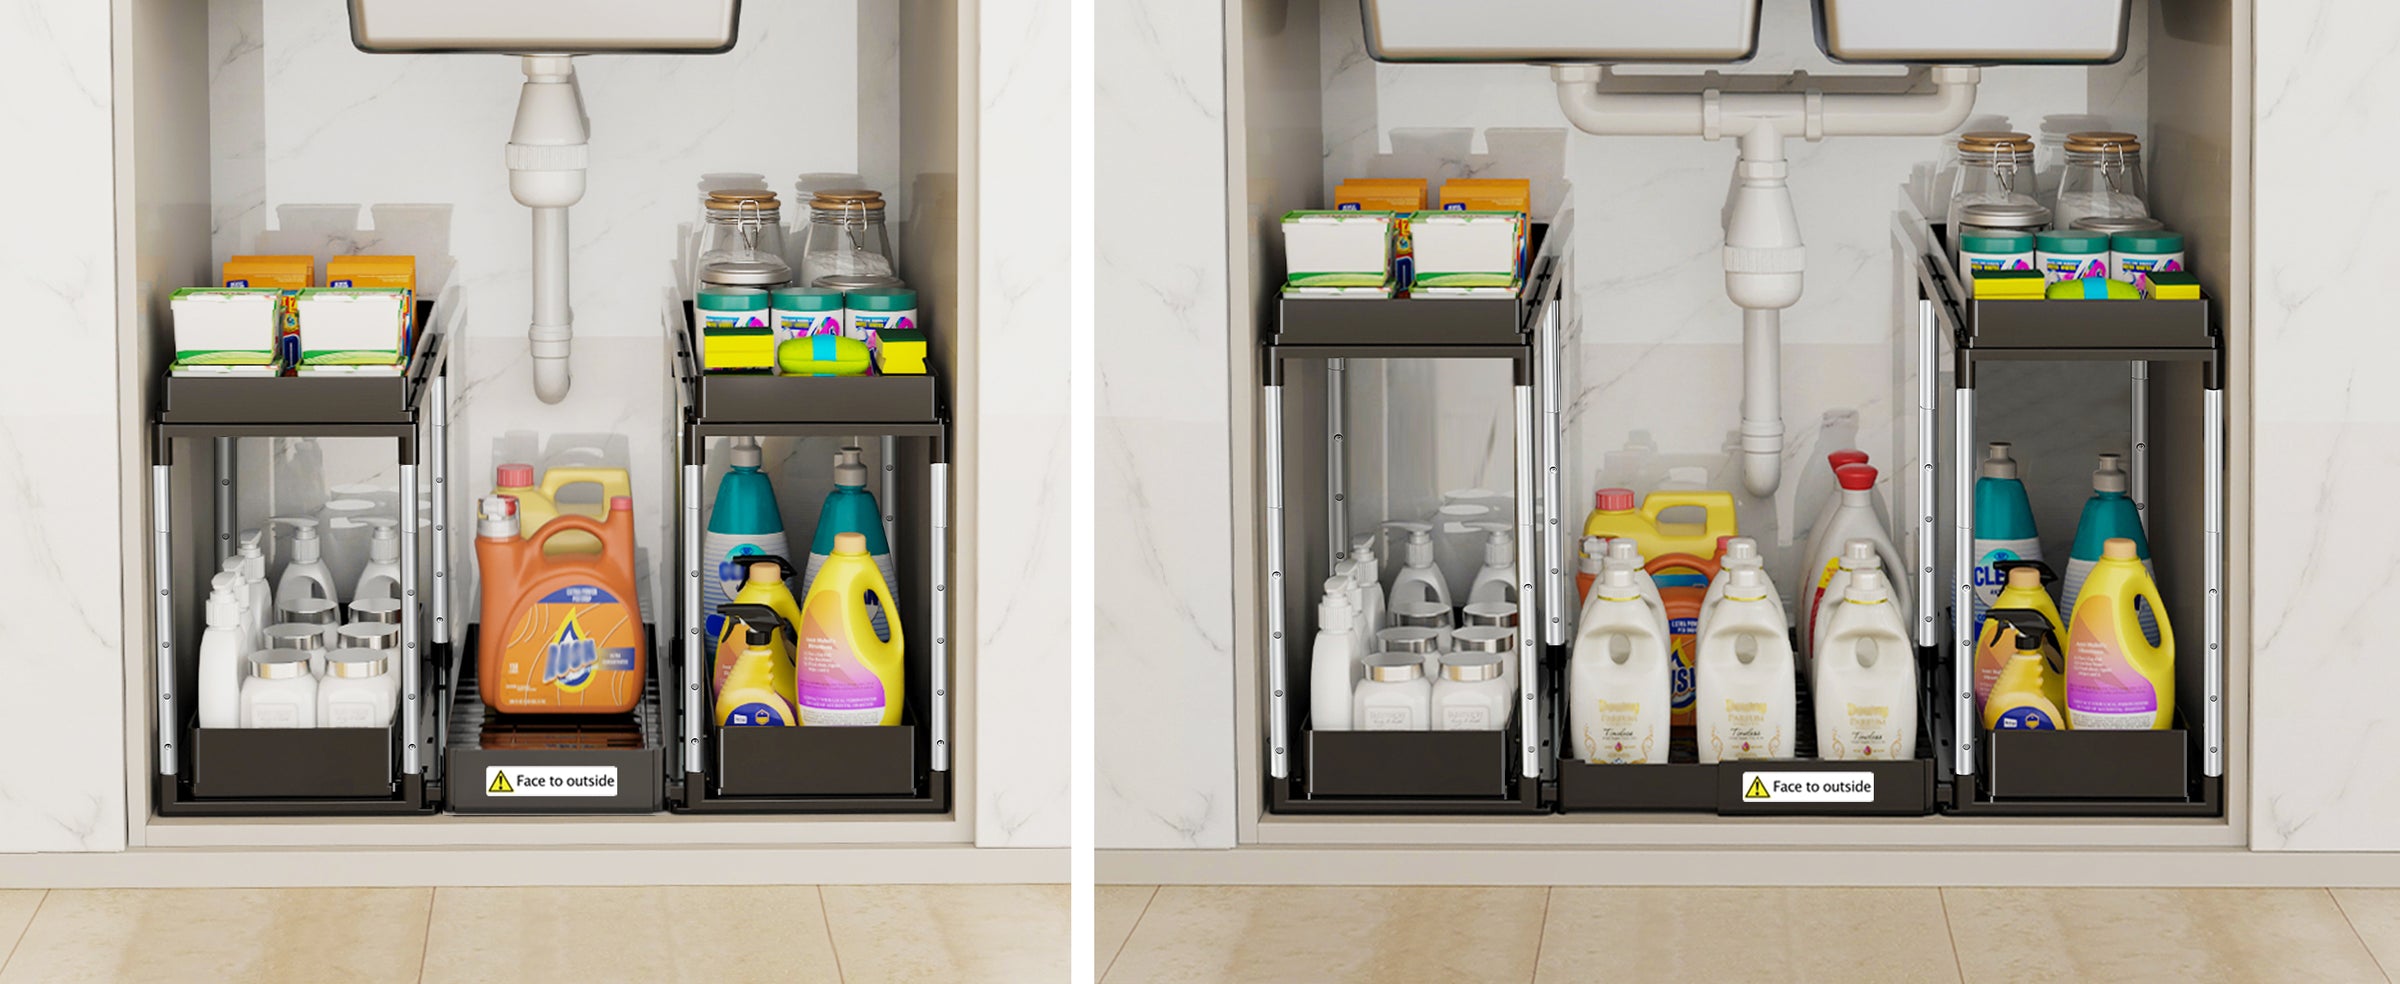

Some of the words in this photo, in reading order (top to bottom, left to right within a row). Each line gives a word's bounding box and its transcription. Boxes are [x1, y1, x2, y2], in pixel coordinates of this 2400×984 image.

[517, 774, 546, 787] Face
[549, 776, 563, 787] to
[566, 774, 615, 787] outside
[1773, 780, 1803, 793] Face
[1806, 782, 1820, 793] to
[1823, 780, 1872, 793] outside
